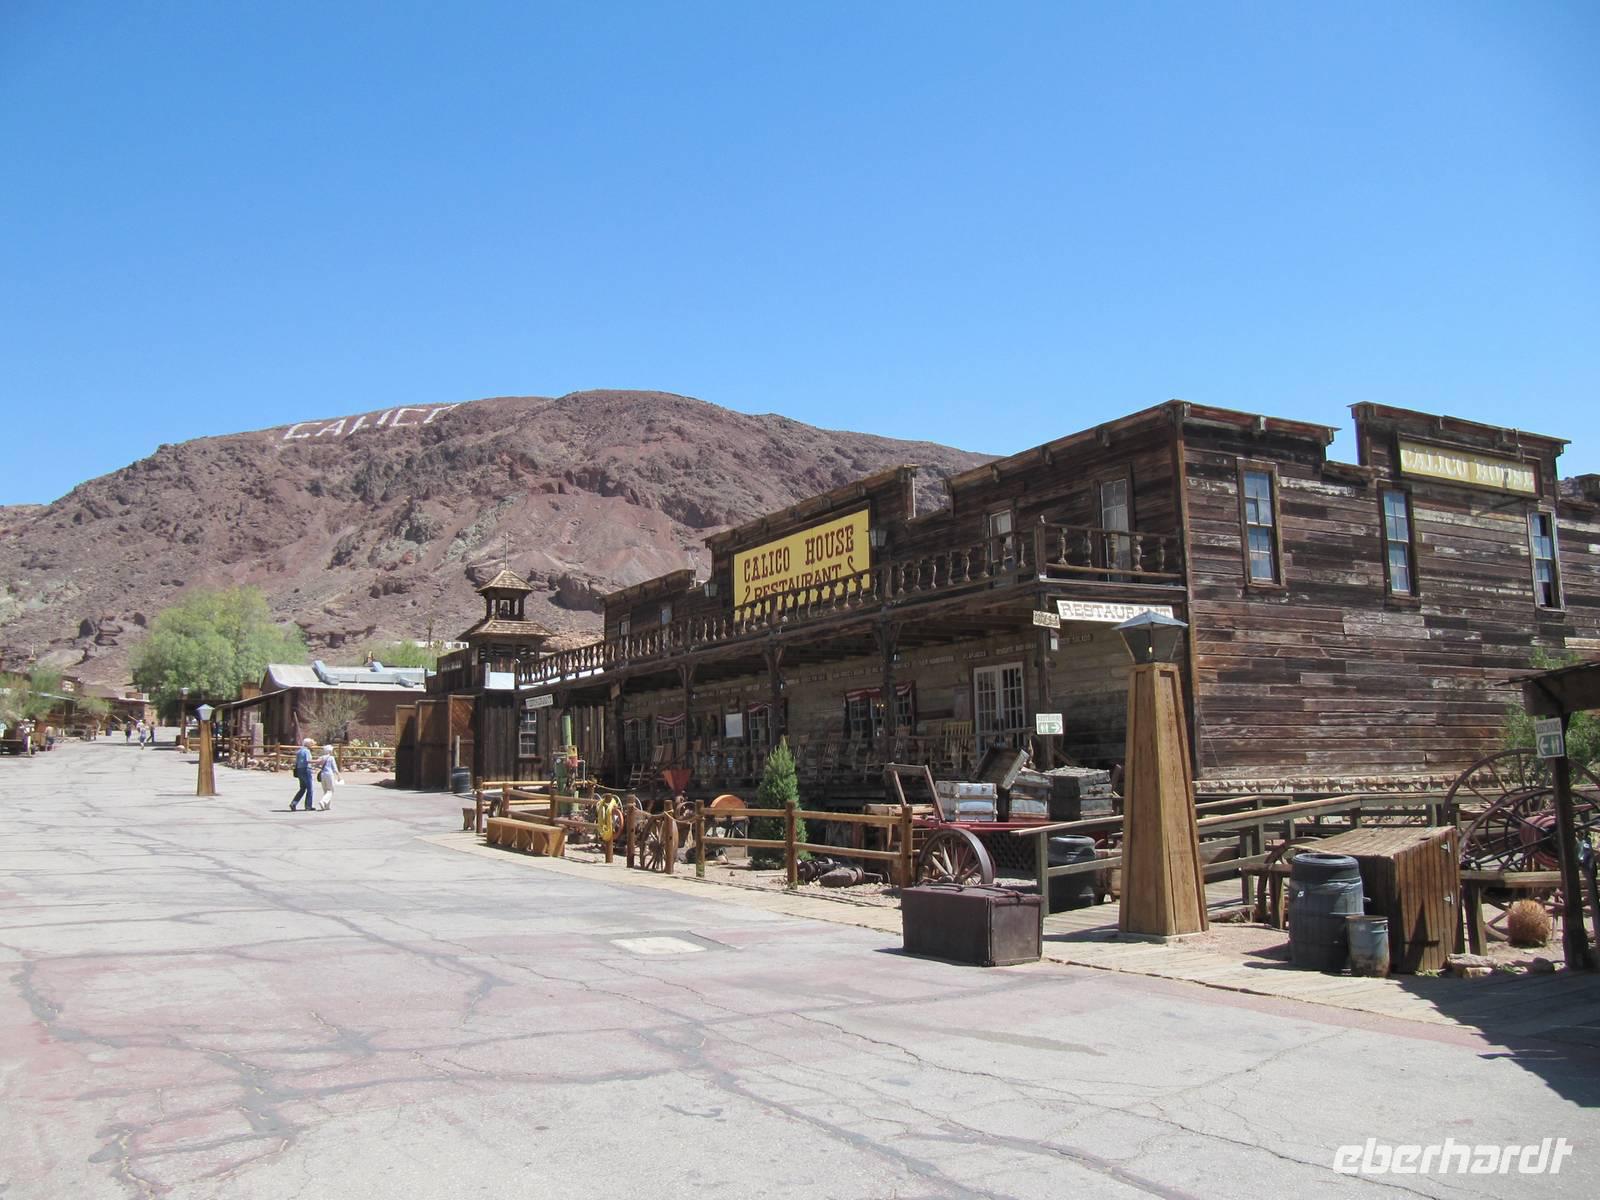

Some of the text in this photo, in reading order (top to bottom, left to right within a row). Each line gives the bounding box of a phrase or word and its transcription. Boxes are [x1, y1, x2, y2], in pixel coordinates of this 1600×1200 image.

[743, 524, 855, 584] CALICO HOUSE
[754, 564, 842, 601] RESTAURANT
